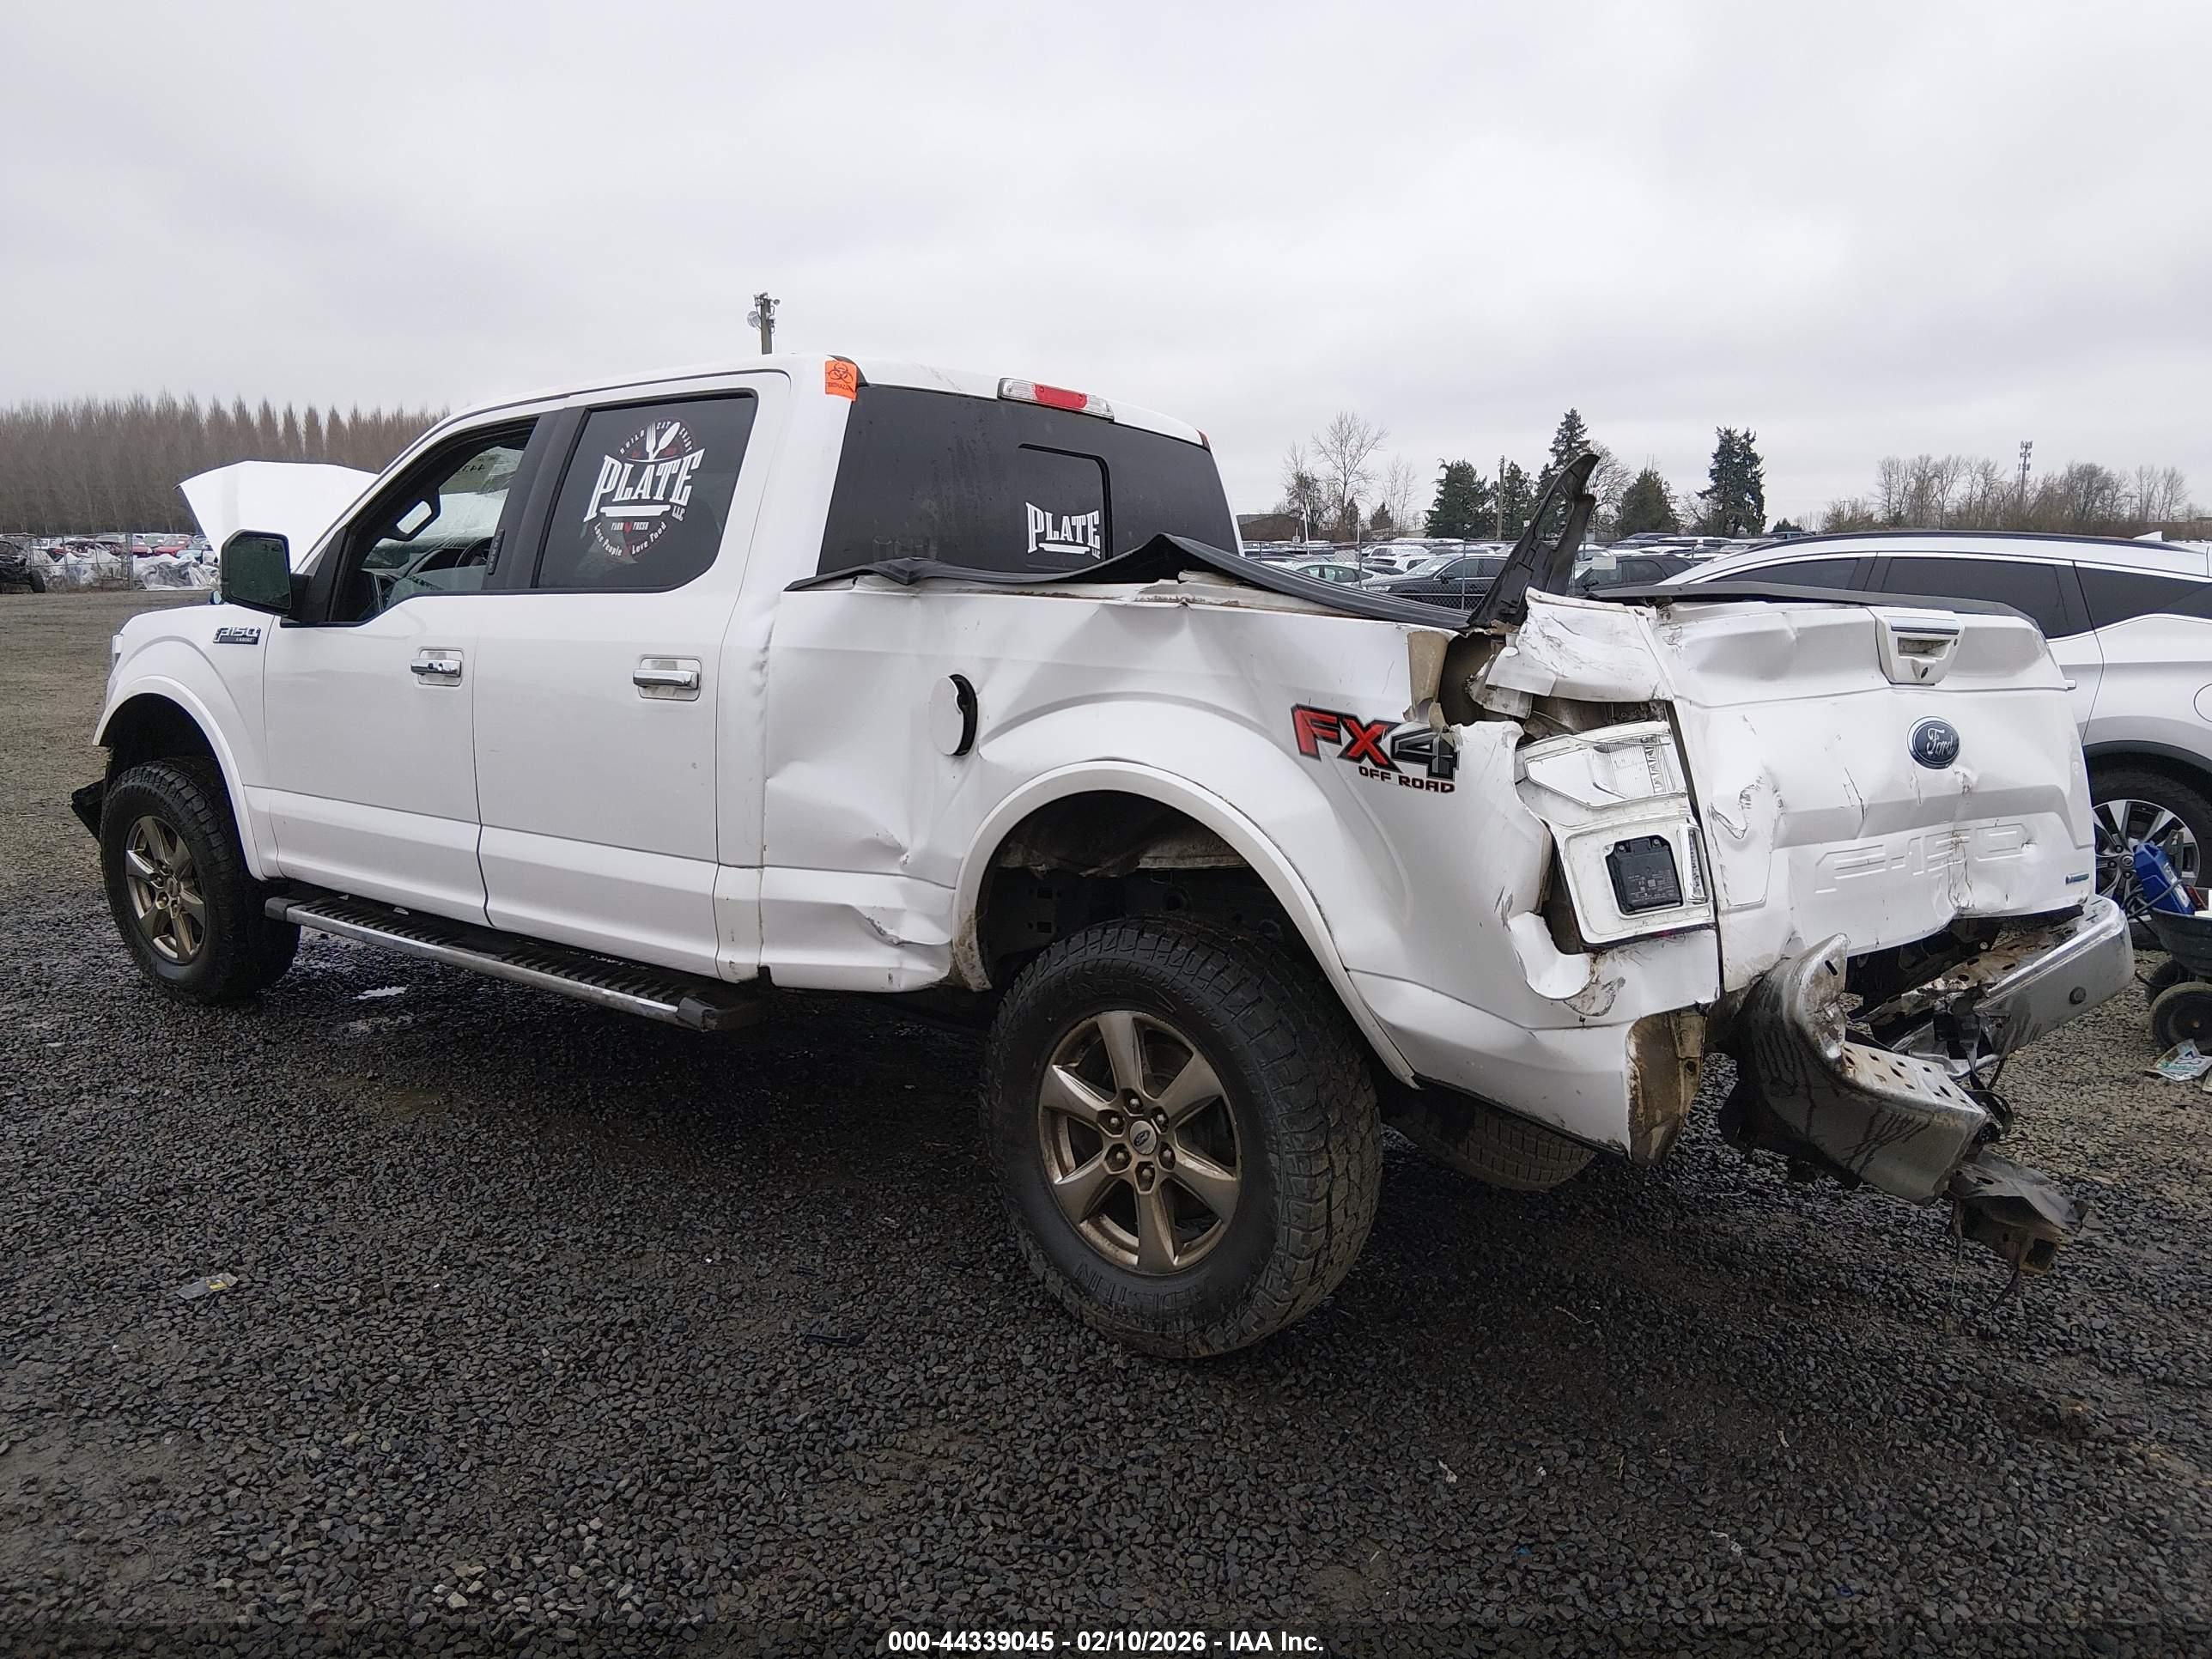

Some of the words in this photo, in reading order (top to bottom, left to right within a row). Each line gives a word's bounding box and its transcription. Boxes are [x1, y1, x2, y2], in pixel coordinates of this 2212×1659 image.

[583, 448, 705, 522] PLATE
[603, 538, 623, 556] People
[632, 541, 648, 555] Love
[649, 521, 666, 543] Food
[1025, 502, 1101, 554] PLATE
[1291, 703, 1460, 781] FX4
[1926, 727, 1954, 756] Ford
[1358, 766, 1391, 782] OFF
[1399, 775, 1455, 793] ROAD
